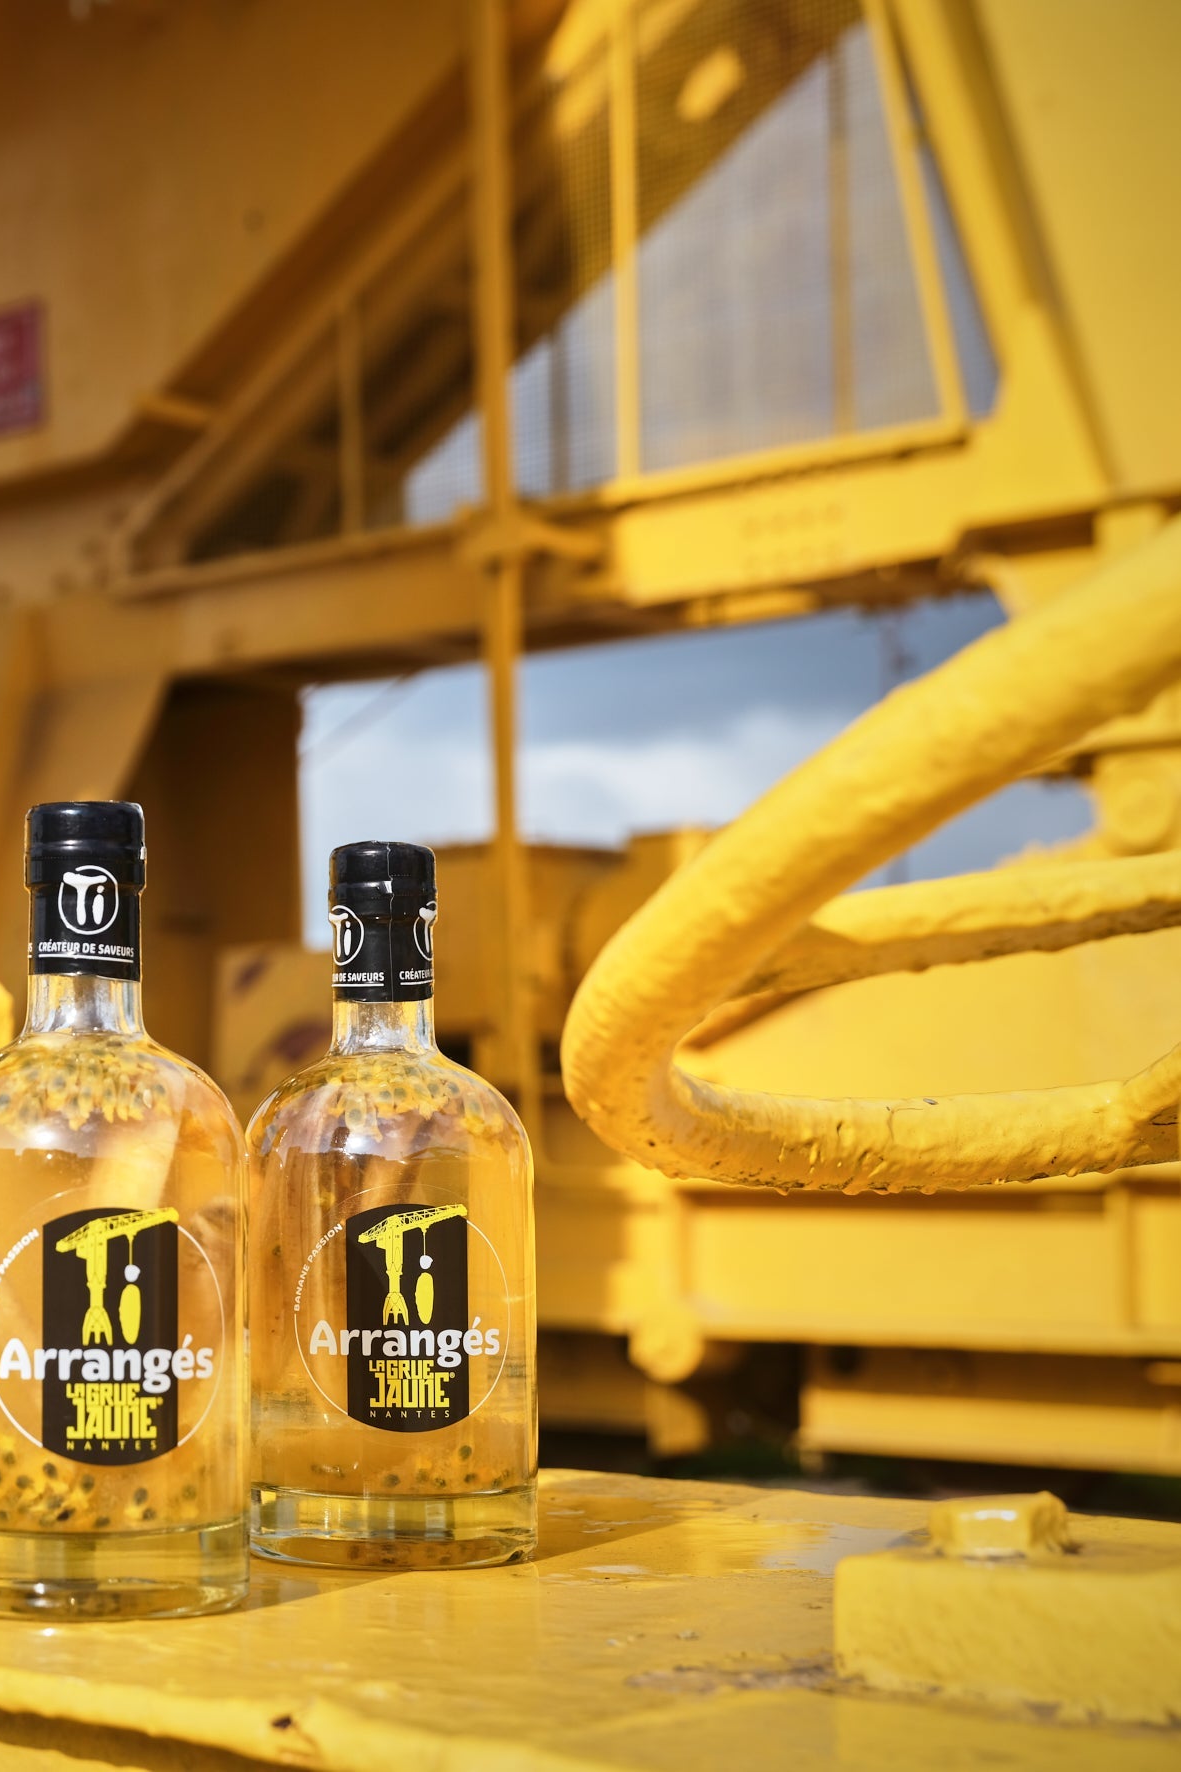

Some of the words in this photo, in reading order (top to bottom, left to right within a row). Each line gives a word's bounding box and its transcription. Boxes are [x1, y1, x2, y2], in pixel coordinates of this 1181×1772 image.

[62, 871, 108, 926] Ti
[38, 939, 80, 954] CRÉATEUR
[81, 942, 95, 954] DE
[97, 945, 135, 958] SAVEURS
[348, 972, 385, 982] SAVEURS
[294, 1265, 310, 1312] BANANE
[307, 1222, 343, 1264] PASSION
[309, 1317, 500, 1368] Arrangés
[369, 1359, 385, 1372] LA
[387, 1359, 433, 1379] GRUE
[66, 1383, 84, 1398] LA
[87, 1383, 137, 1405] GRUE
[369, 1410, 450, 1418] NANTES
[66, 1441, 157, 1450] NANTES
